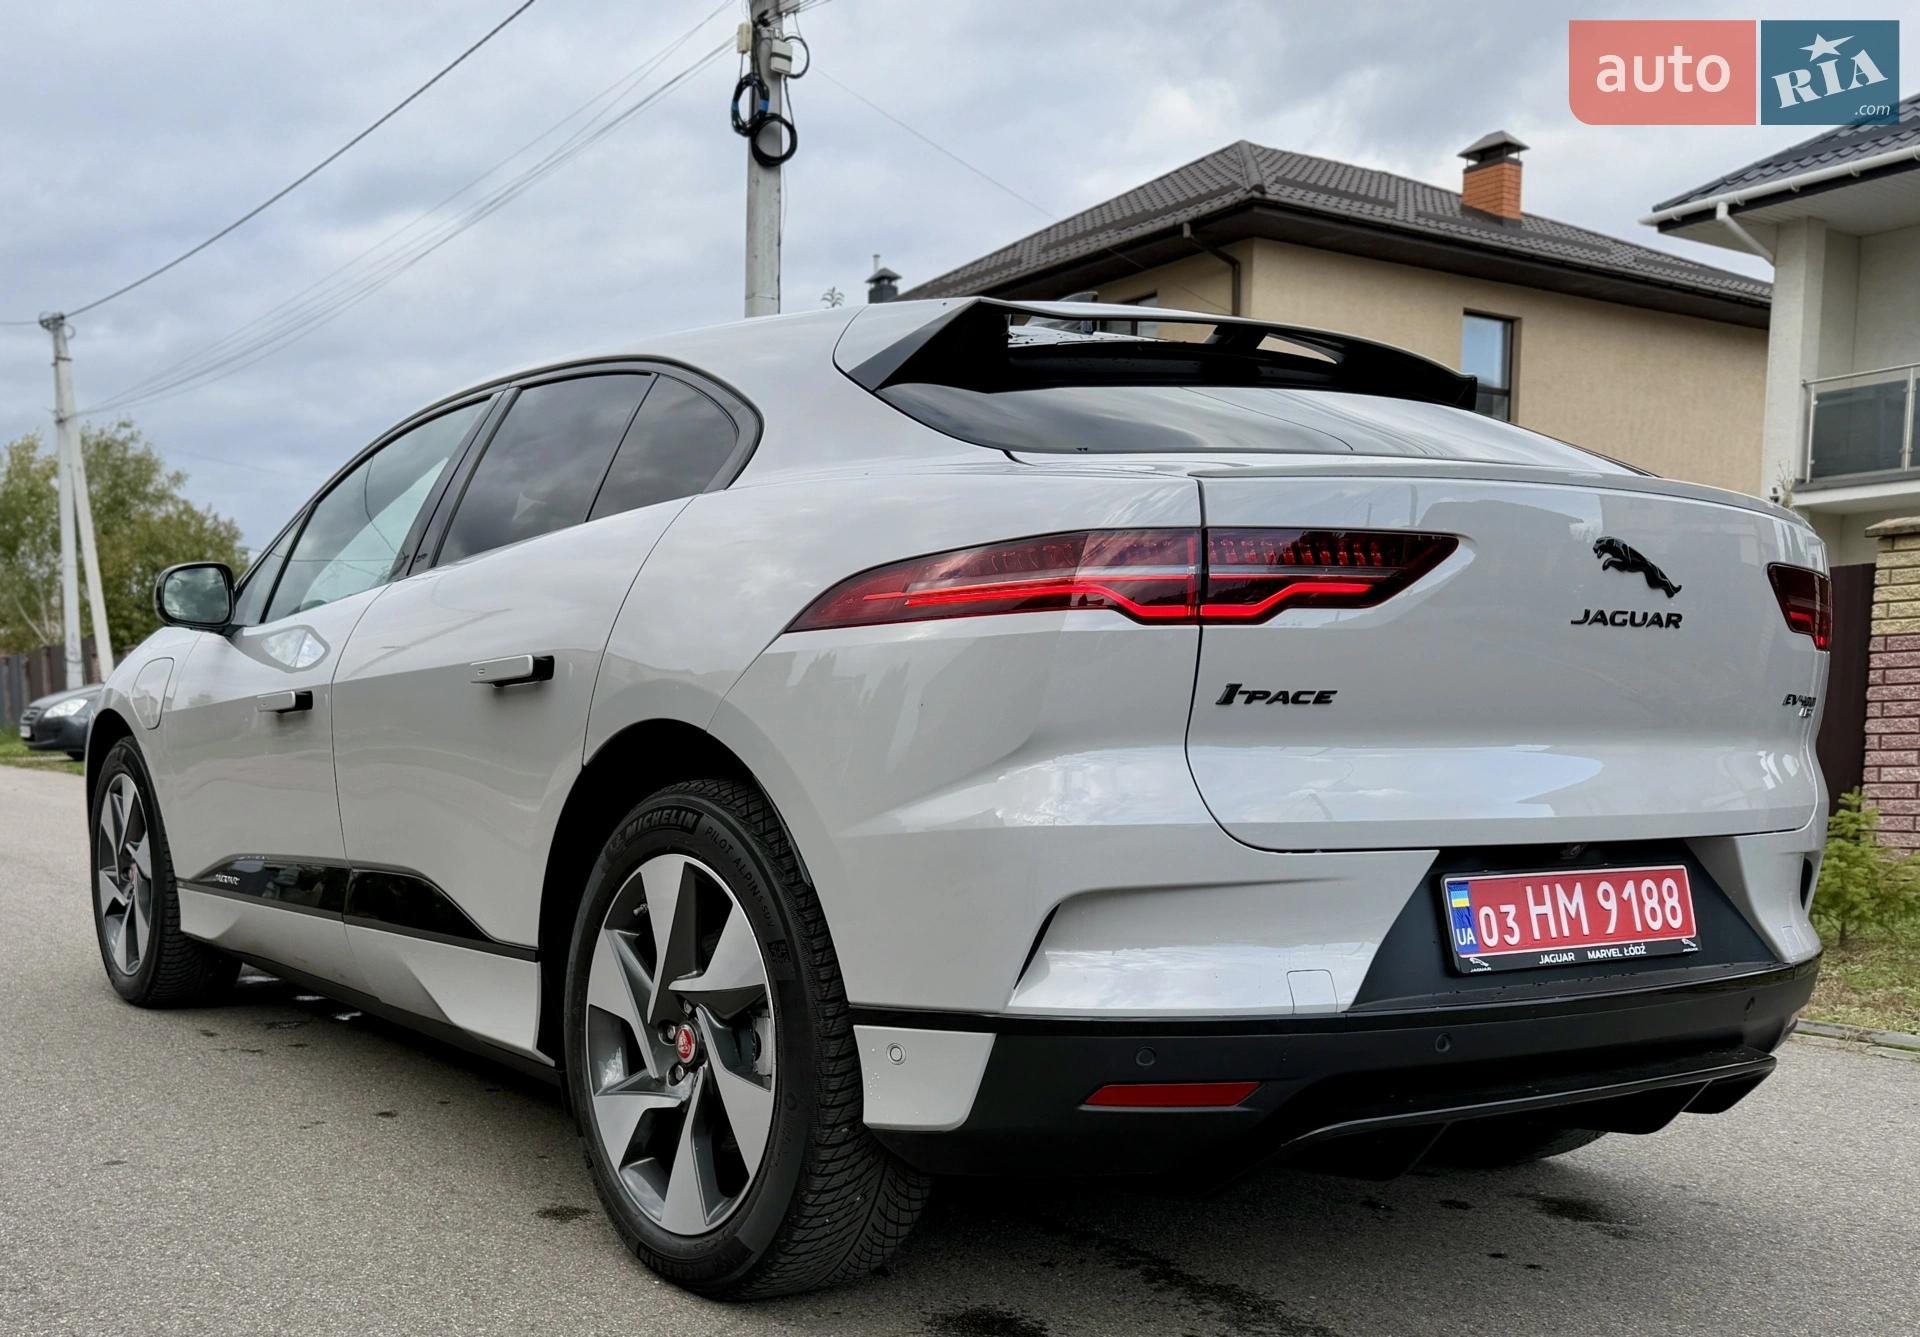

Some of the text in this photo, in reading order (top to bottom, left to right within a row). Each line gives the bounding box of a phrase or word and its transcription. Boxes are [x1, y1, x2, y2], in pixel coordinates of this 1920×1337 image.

[1571, 608, 1683, 629] JAGUAR
[624, 809, 700, 840] MICHELIN
[705, 826, 735, 855] PILOT
[1479, 877, 1683, 948] 03 HM 9188
[1456, 927, 1477, 946] UA
[1538, 952, 1575, 965] JAGUAR
[1587, 947, 1623, 960] MARVEL
